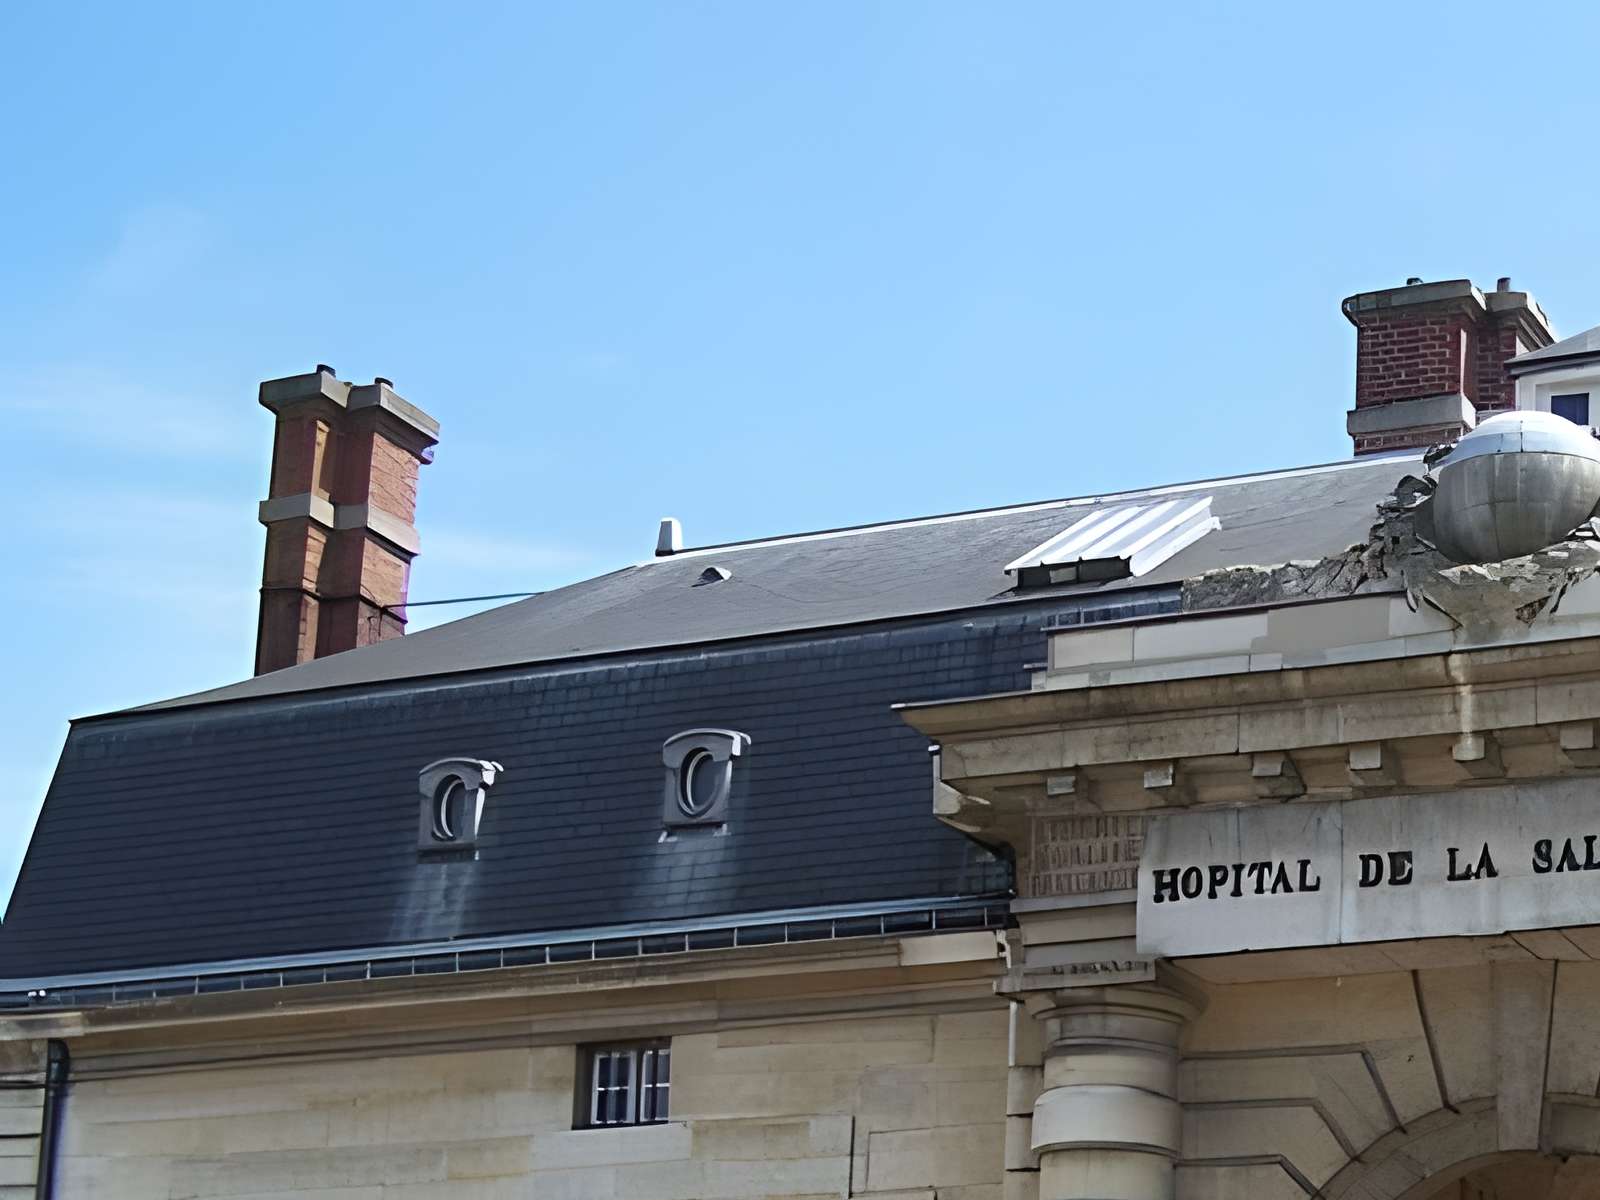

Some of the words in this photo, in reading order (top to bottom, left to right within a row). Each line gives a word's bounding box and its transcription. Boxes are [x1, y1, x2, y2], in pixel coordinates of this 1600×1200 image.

[1152, 858, 1322, 904] HOPITAL
[1358, 850, 1413, 888] DE
[1446, 841, 1499, 882] LA
